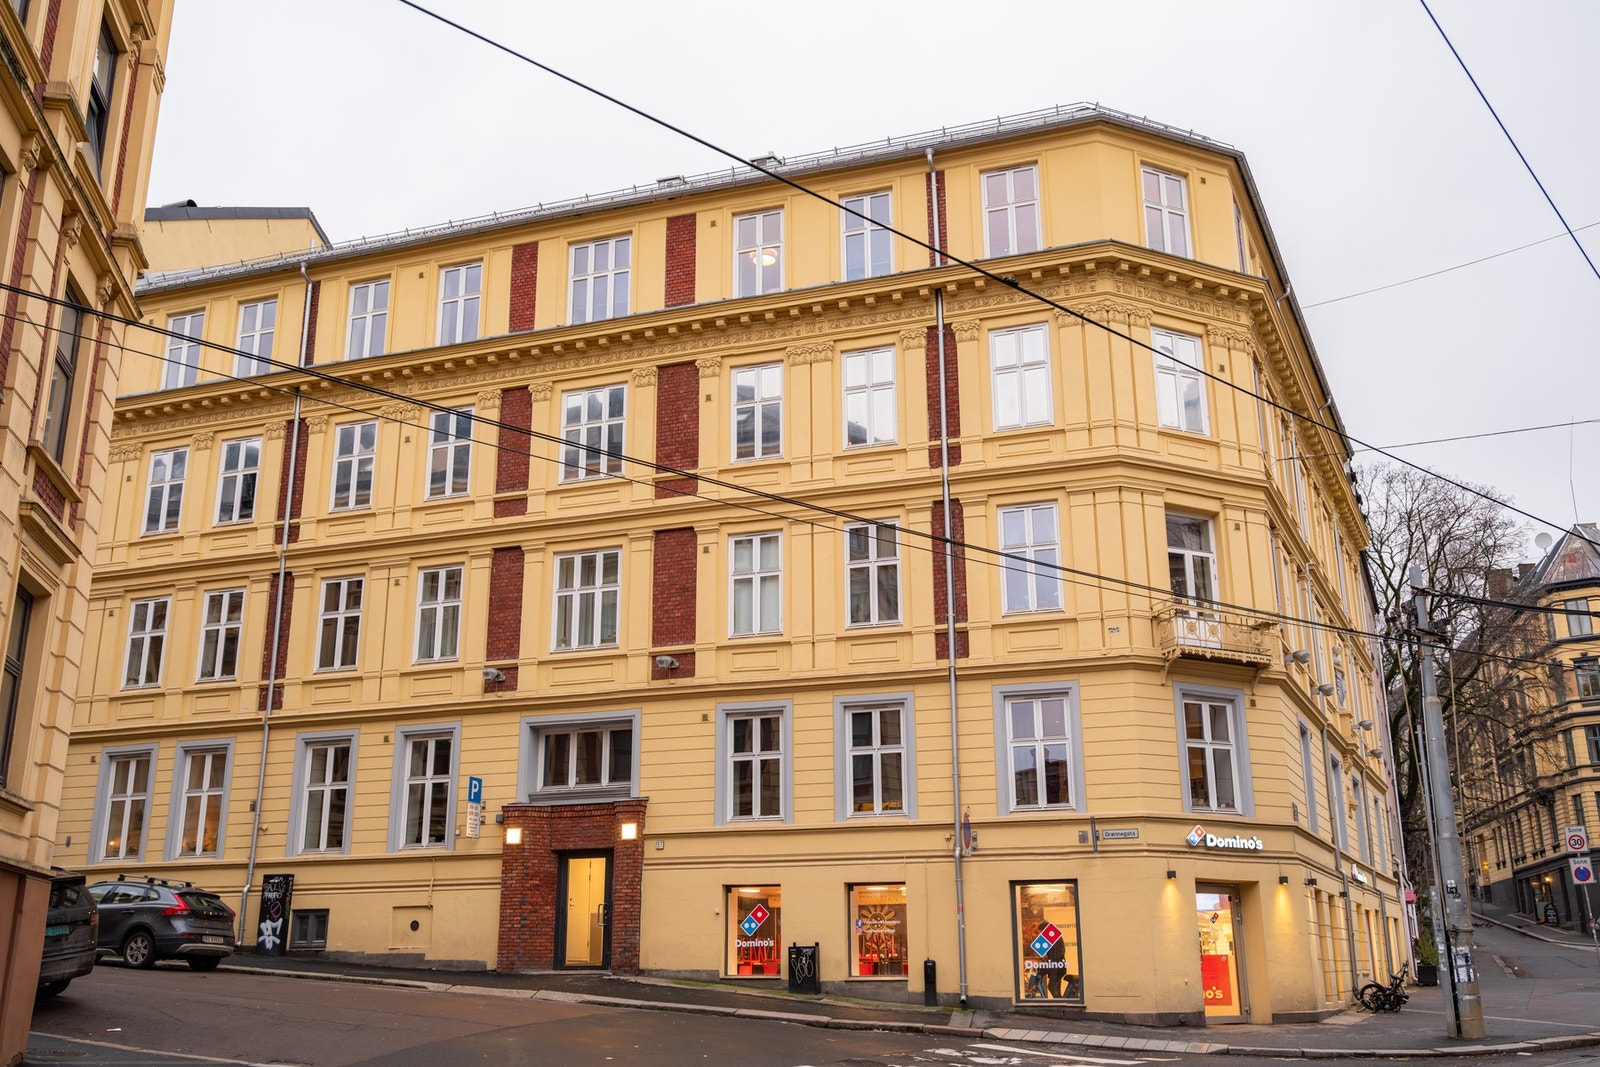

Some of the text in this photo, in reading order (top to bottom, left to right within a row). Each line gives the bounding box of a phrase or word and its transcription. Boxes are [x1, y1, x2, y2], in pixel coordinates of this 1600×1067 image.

[471, 780, 479, 800] P
[1205, 834, 1264, 850] Domino's
[1571, 838, 1582, 847] 30
[735, 938, 774, 948] Domino's
[1025, 959, 1070, 969] Domino's
